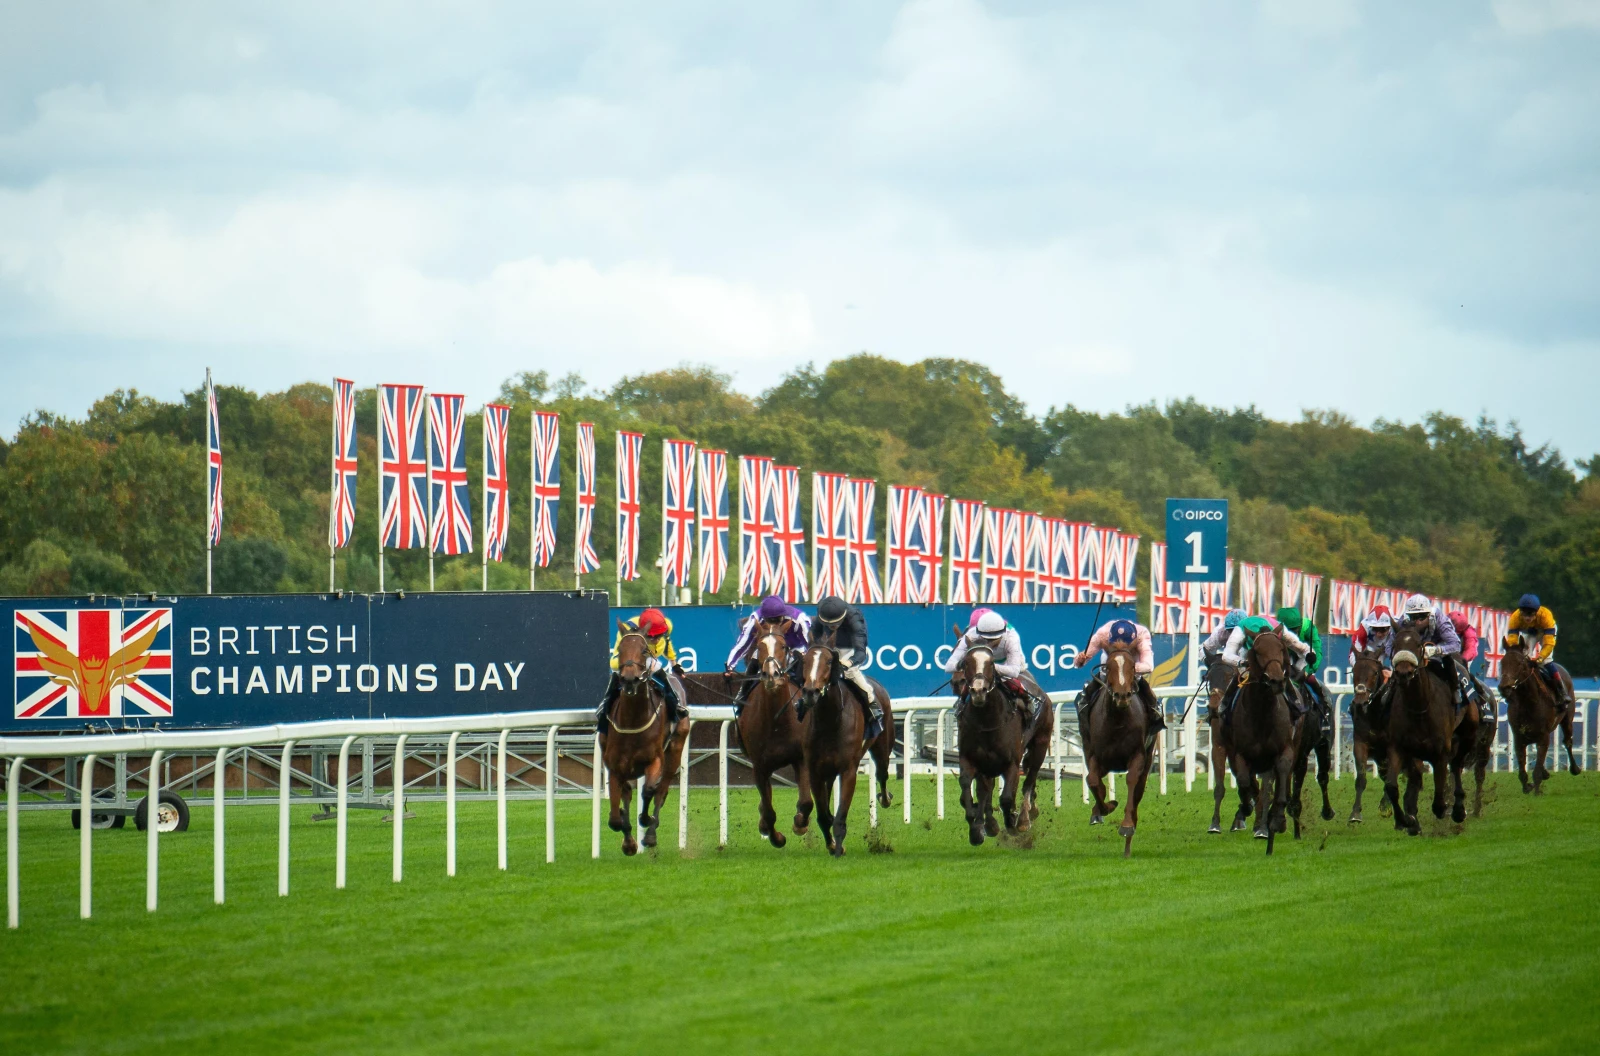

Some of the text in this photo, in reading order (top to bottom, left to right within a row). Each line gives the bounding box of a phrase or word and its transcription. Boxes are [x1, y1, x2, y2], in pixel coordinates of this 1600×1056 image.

[1184, 531, 1209, 573] 1
[190, 625, 357, 655] BRITISH
[190, 662, 526, 695] CHAMPIONS DAY
